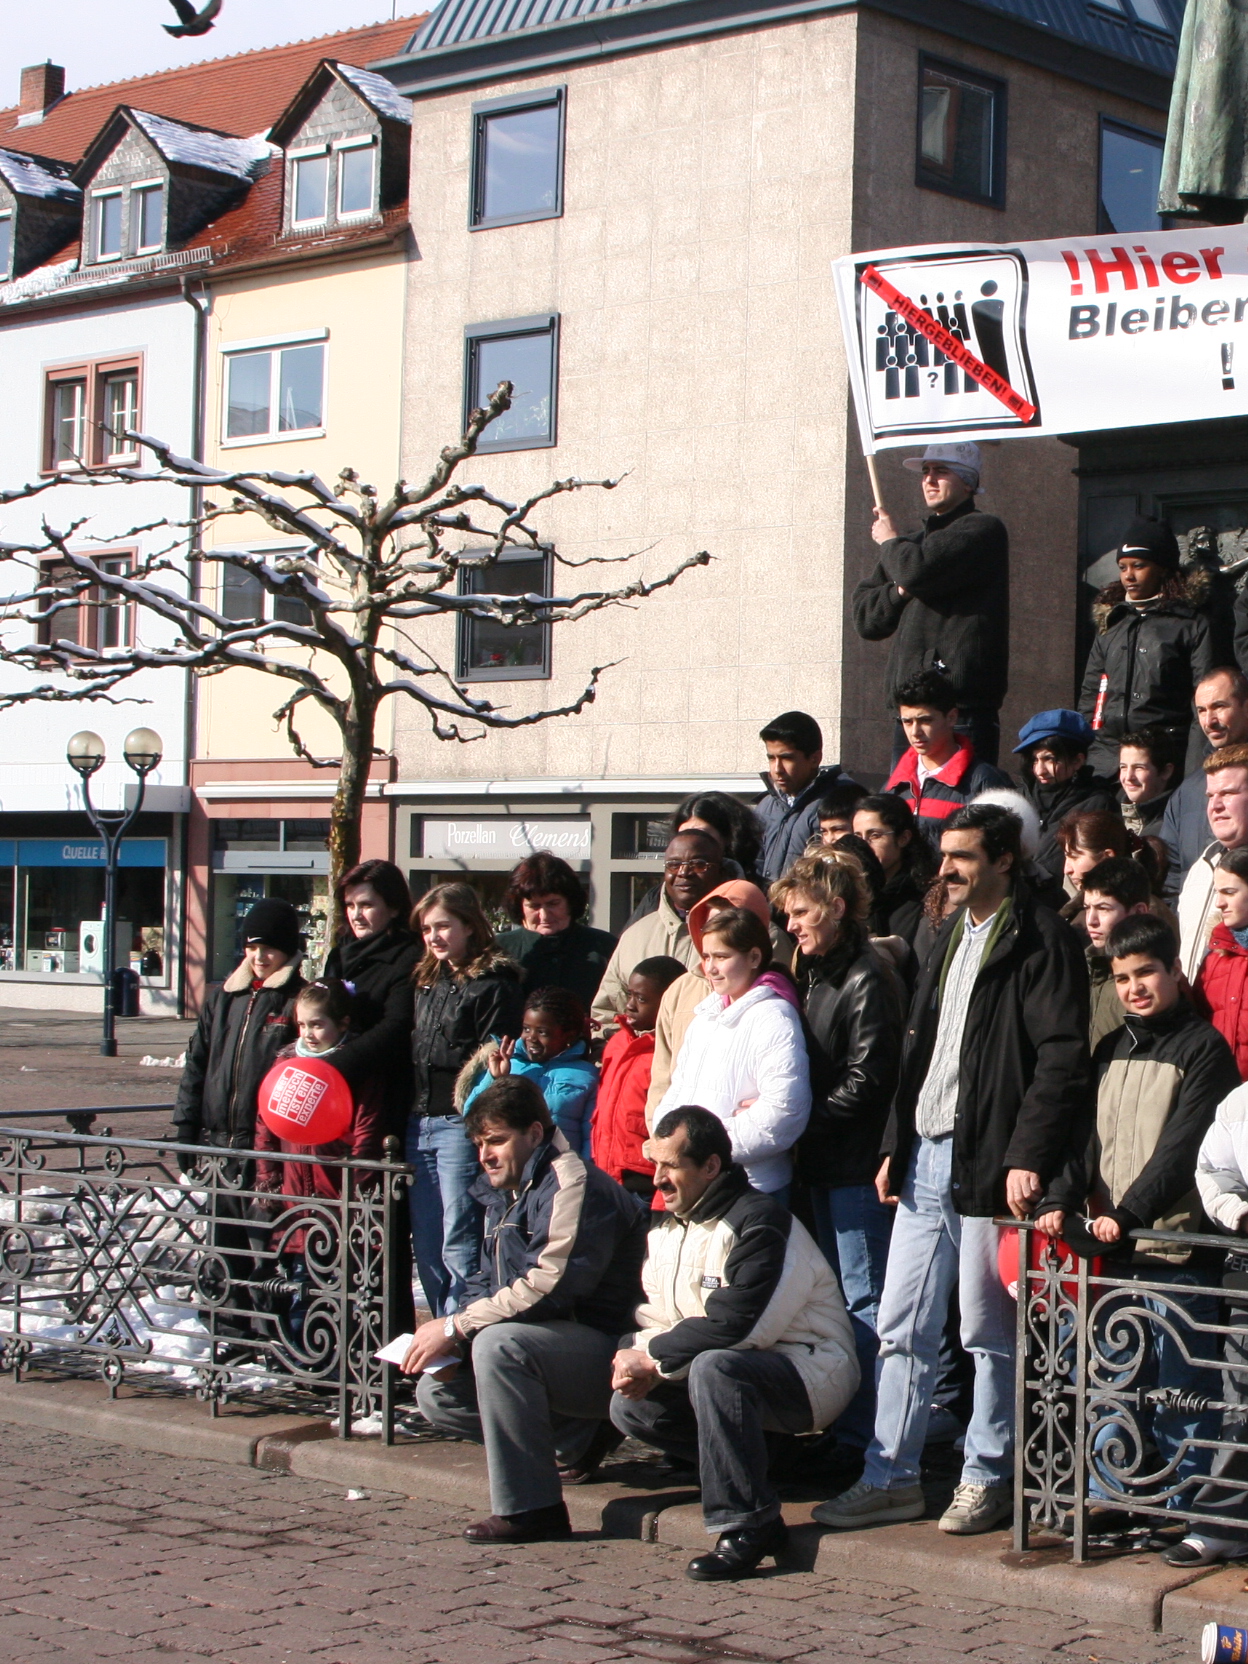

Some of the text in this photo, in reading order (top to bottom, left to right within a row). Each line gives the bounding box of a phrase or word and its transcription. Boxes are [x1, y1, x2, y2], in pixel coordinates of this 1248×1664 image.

[447, 822, 589, 848] Porzellan Clemens
[62, 845, 99, 860] QUELLE
[278, 1071, 305, 1115] mensch
[297, 1080, 312, 1099] ein
[299, 1083, 324, 1122] experte
